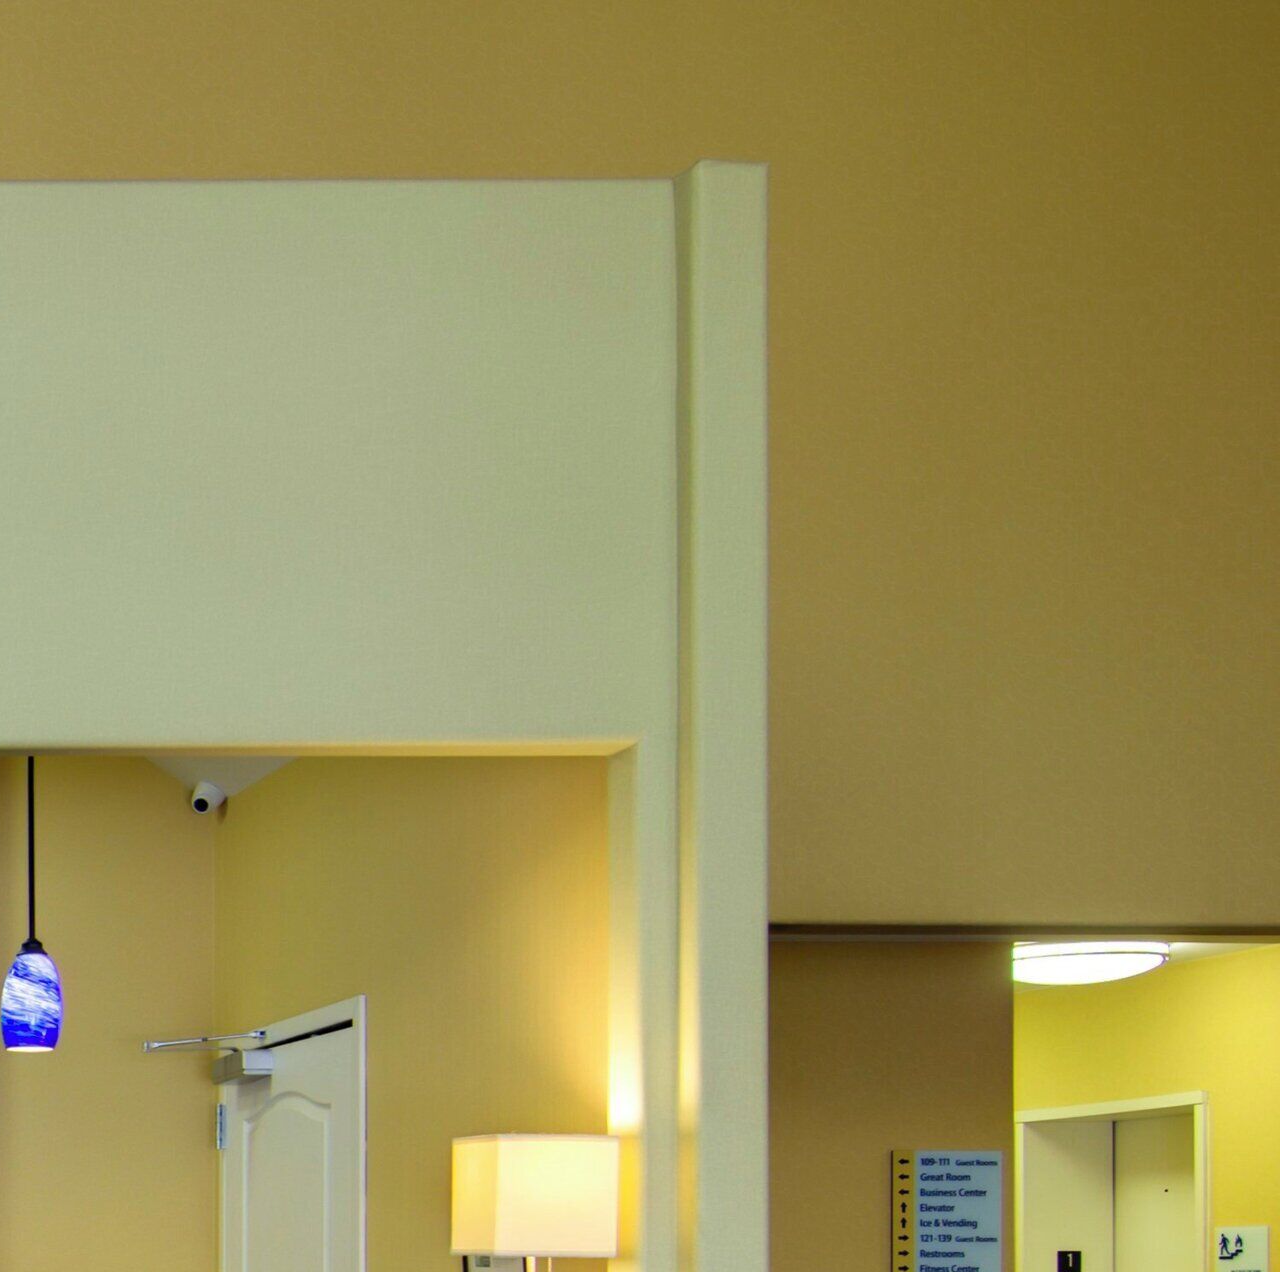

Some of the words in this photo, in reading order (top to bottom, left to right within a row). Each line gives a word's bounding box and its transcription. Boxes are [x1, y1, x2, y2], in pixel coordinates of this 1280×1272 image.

[920, 1173, 944, 1181] Great
[946, 1173, 971, 1181] Room
[920, 1188, 957, 1197] Business
[958, 1188, 988, 1197] Center
[920, 1203, 955, 1212] Elevator
[920, 1219, 932, 1227] Ice
[941, 1219, 978, 1230] Vending
[920, 1249, 965, 1258] Restrooms
[920, 1264, 950, 1272] Fitness
[951, 1264, 980, 1272] Center
